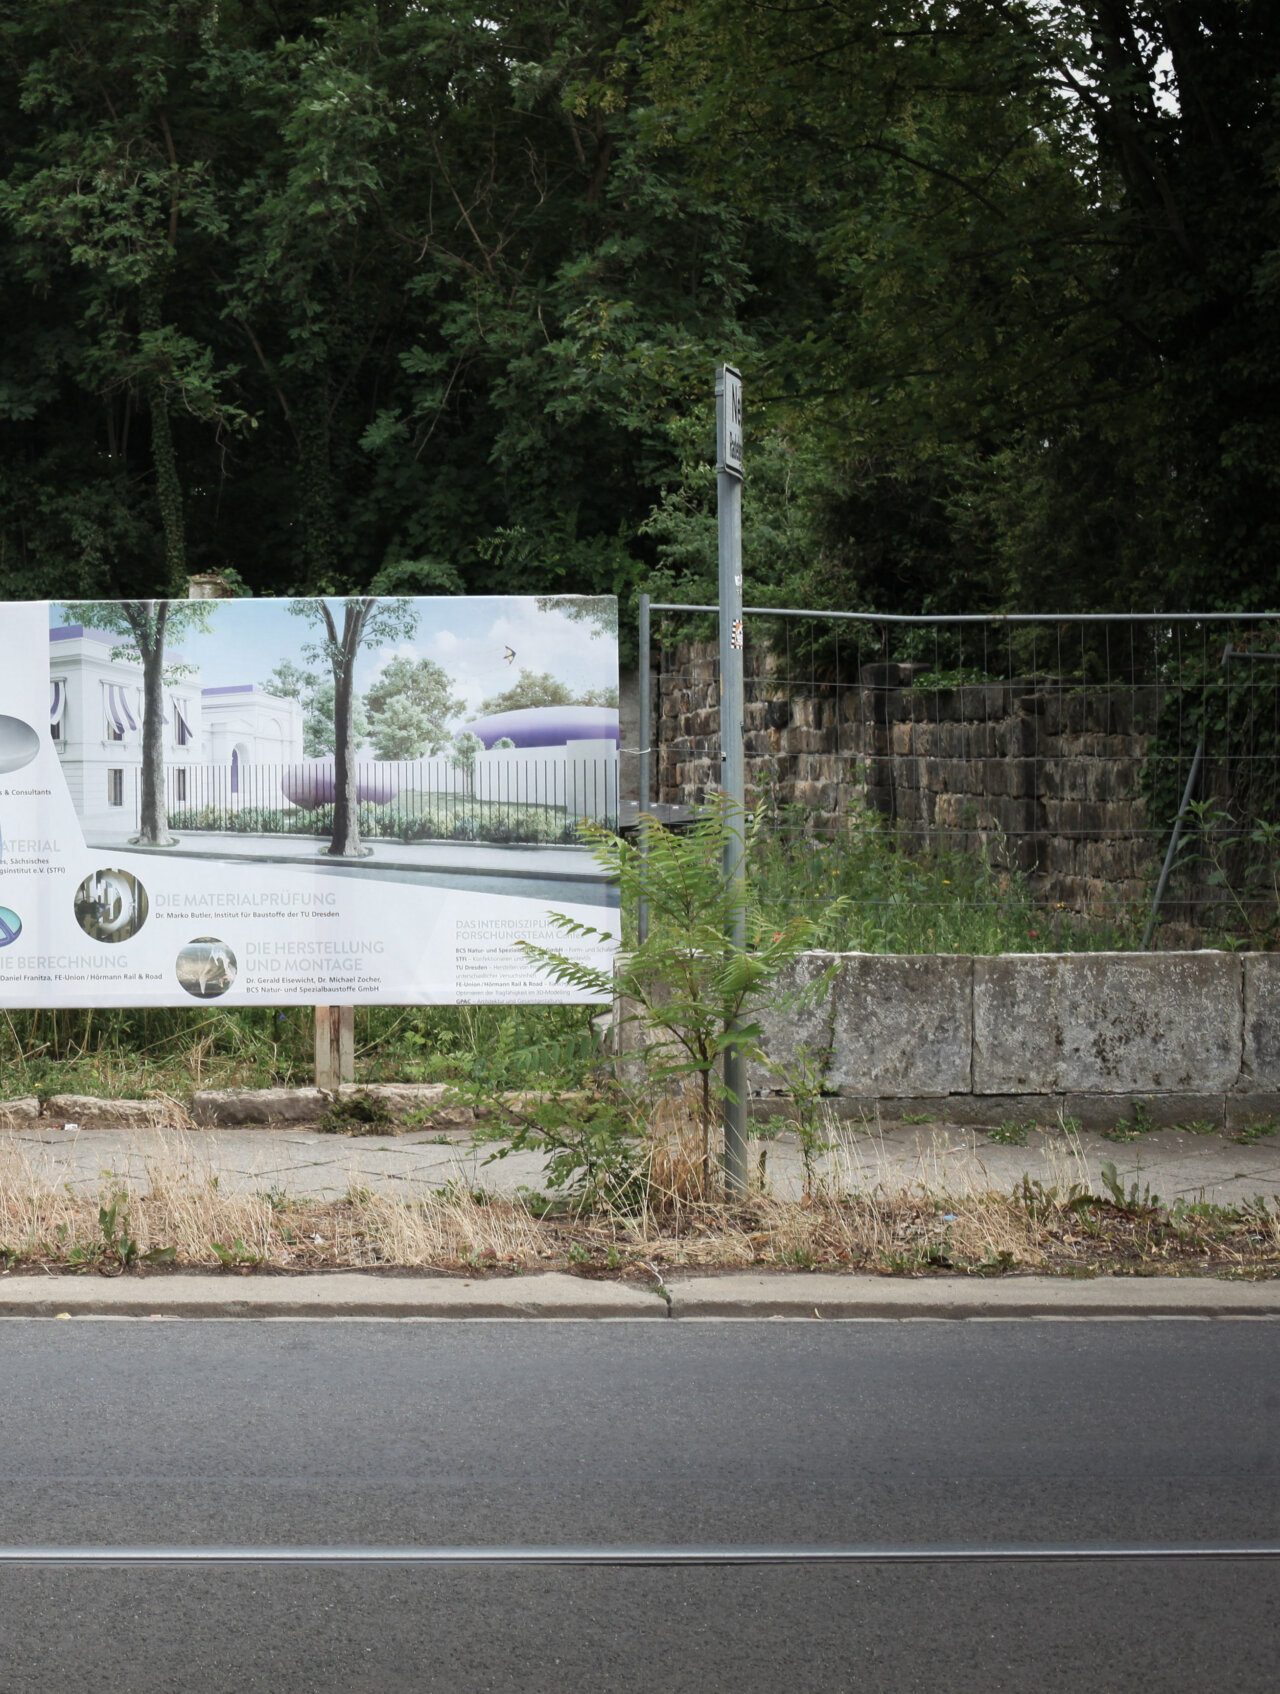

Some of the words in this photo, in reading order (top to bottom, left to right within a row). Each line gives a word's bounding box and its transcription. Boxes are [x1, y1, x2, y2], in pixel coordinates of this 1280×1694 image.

[2, 839, 61, 852] ATERIAL
[155, 893, 180, 907] DIE
[184, 890, 336, 906] MATERIALPRÜFUNG
[191, 912, 212, 920] Butler,
[456, 920, 478, 929] DAS
[456, 931, 554, 940] FORSCHUNGSTEAM
[246, 942, 271, 955] DIE
[275, 941, 384, 954] HERSTELLUNG
[17, 955, 128, 970] BERECHNUNG
[246, 959, 281, 972] UND
[285, 958, 363, 971] MONTAGE
[23, 974, 52, 983] Franitza,
[357, 976, 381, 984] Zocher,
[299, 986, 356, 994] Spezialbaustoffe
